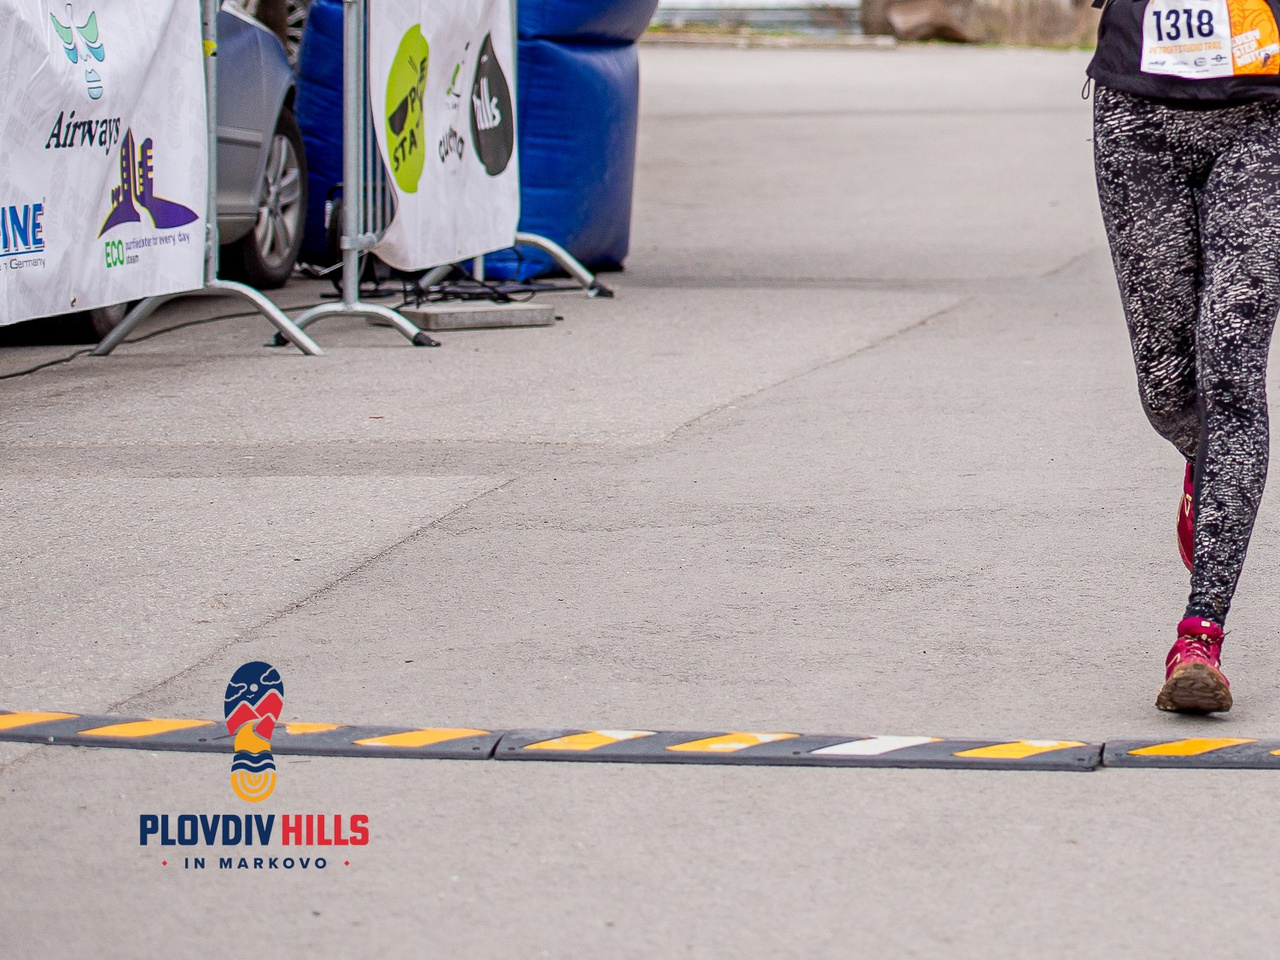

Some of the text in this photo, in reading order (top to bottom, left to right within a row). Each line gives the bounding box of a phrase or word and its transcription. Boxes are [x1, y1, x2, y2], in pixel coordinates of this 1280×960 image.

[1153, 9, 1214, 41] 1318
[45, 110, 121, 156] Airways
[1, 203, 45, 252] INE
[10, 258, 46, 270] Germany
[105, 239, 124, 268] ECO
[178, 231, 190, 244] day
